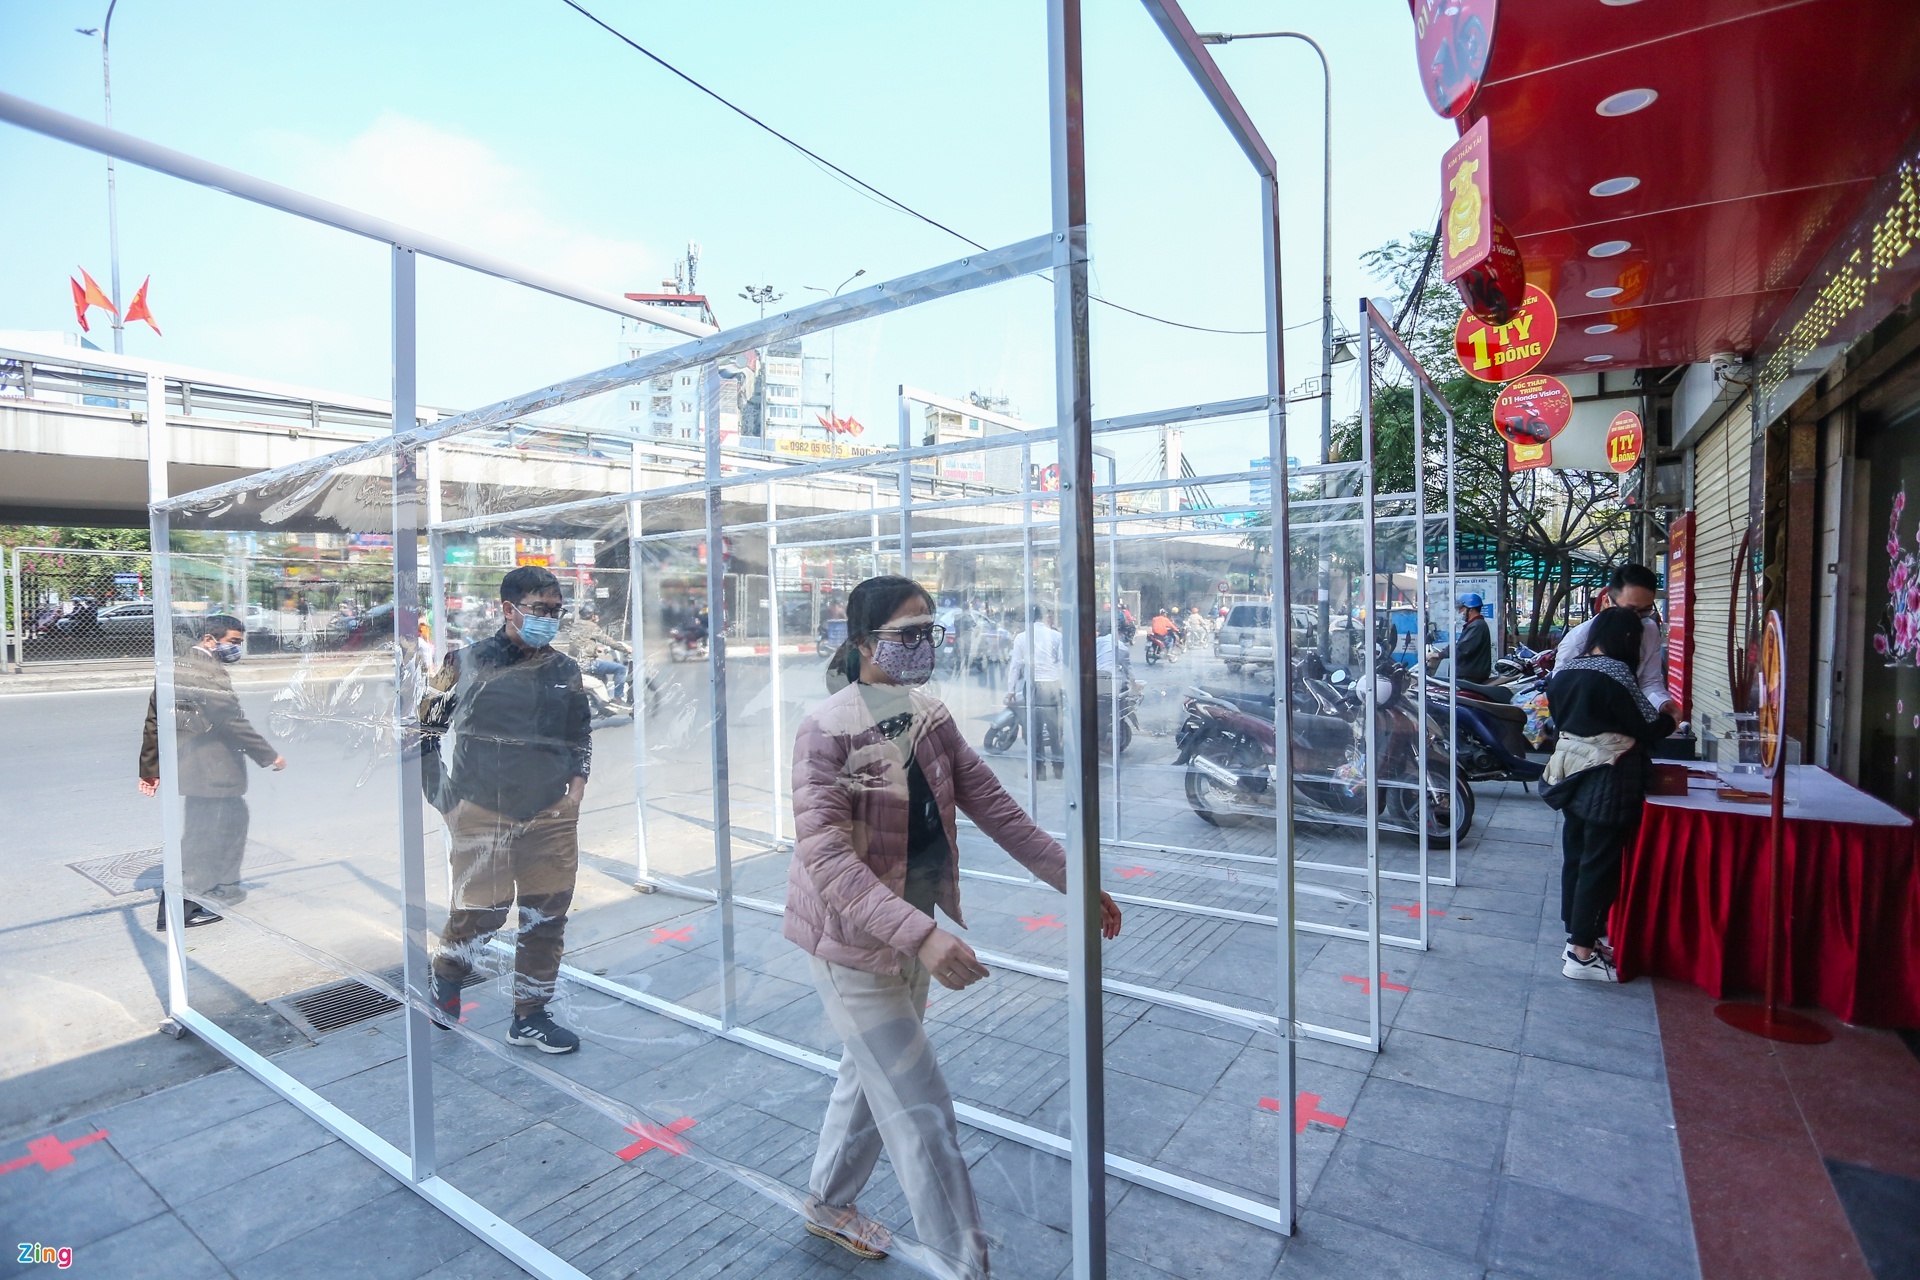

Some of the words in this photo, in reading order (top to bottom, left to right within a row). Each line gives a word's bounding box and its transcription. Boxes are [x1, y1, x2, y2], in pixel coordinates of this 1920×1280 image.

[1447, 157, 1457, 170] KIM
[1497, 245, 1516, 256] Vision
[1468, 327, 1492, 371] 1
[1493, 310, 1533, 346] TỶ
[1494, 342, 1541, 366] ĐỒNG
[1501, 396, 1513, 406] 01
[1514, 392, 1538, 403] Honda
[1539, 388, 1561, 398] Vision
[1611, 437, 1618, 463] 1
[1620, 431, 1634, 451] TỶ
[1619, 450, 1636, 462] ĐỒNG
